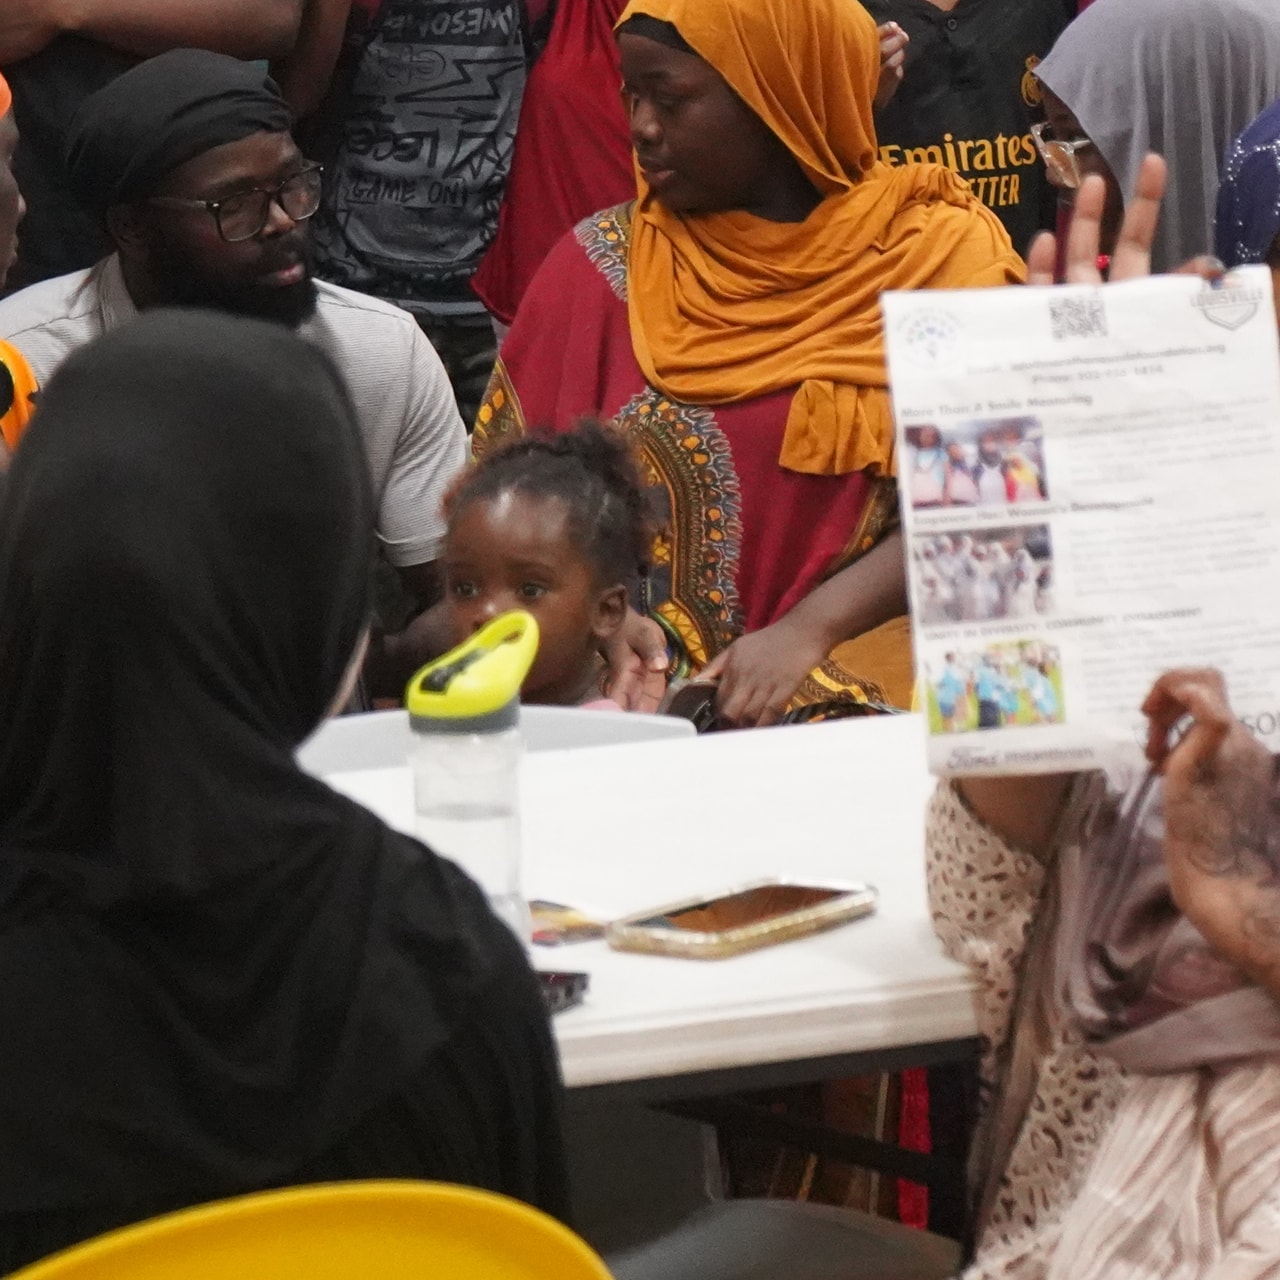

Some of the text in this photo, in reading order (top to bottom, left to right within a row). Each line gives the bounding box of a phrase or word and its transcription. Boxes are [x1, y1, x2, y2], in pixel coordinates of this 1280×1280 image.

[879, 132, 1036, 172] Emirates
[900, 393, 1094, 419] More Than A Smile Mentoring
